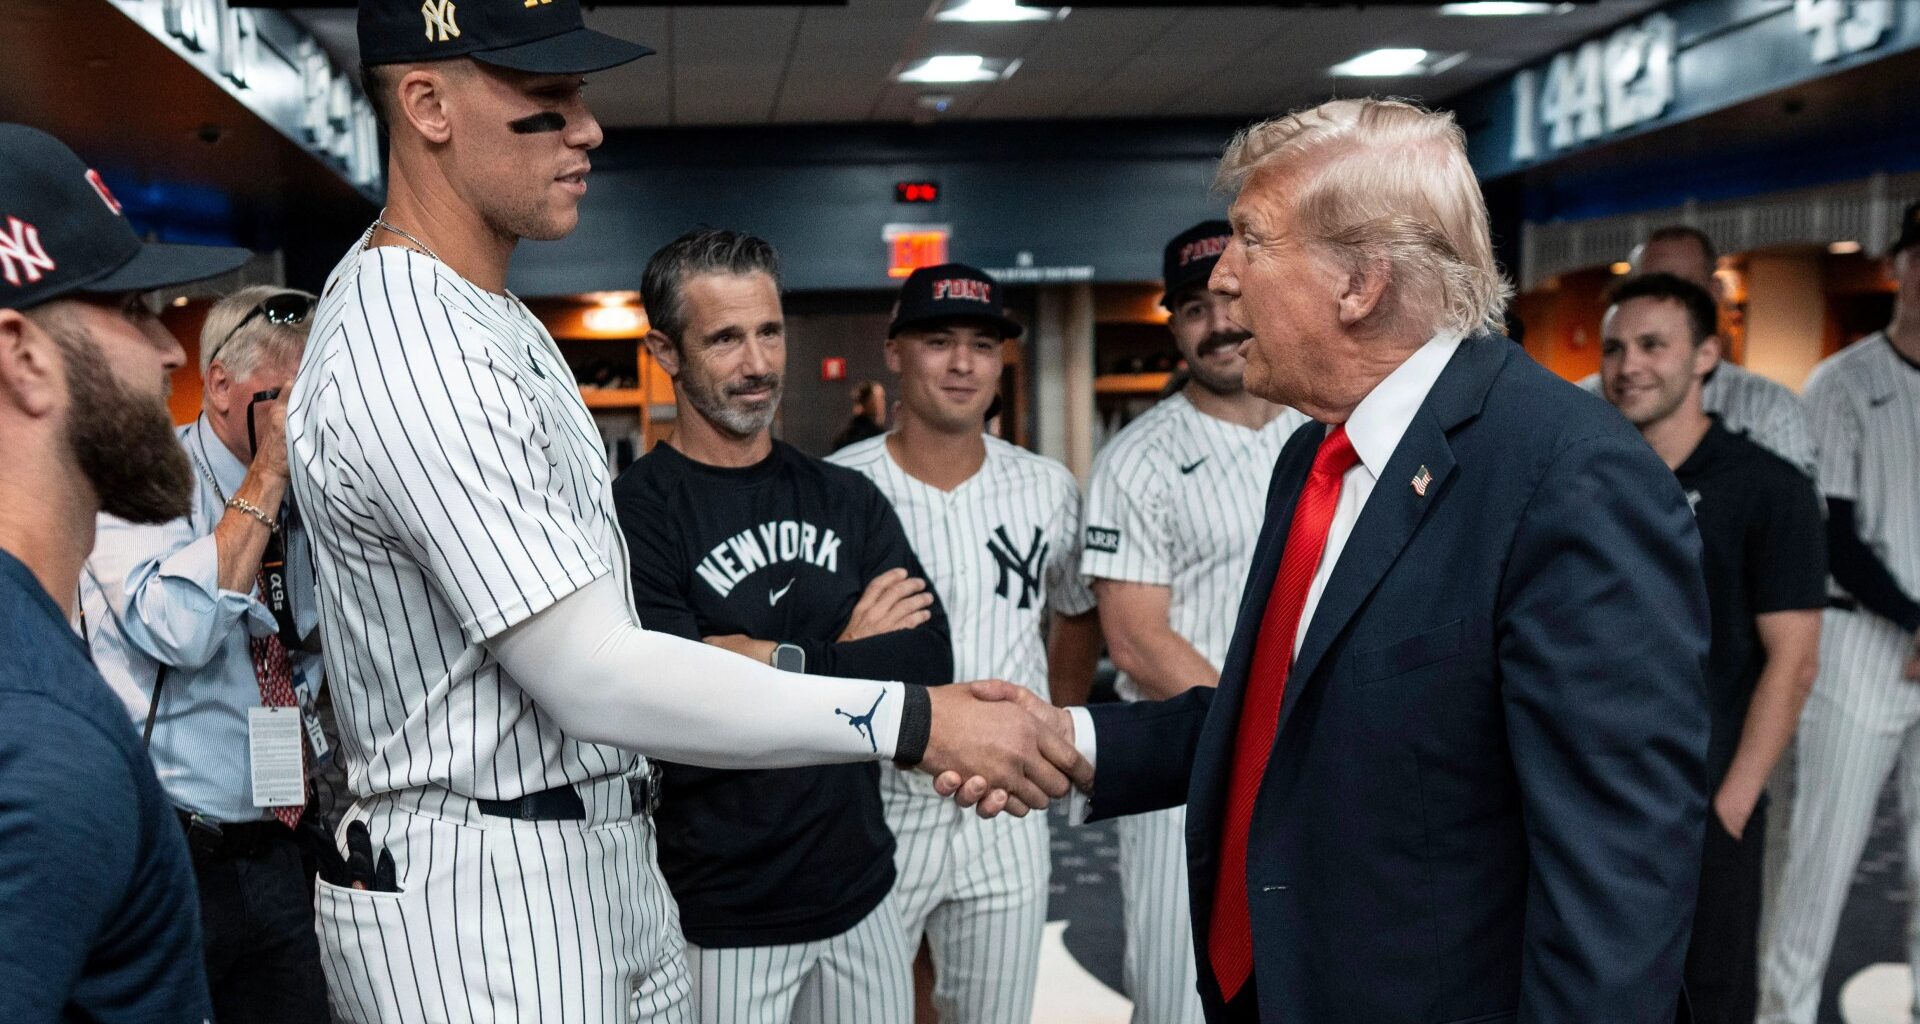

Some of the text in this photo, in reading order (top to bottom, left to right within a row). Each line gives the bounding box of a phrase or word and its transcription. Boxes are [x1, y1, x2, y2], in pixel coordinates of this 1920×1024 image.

[421, 0, 461, 42] NY
[0, 214, 56, 286] NY
[933, 278, 991, 303] FDNY
[695, 520, 842, 598] NEW YORK
[986, 525, 1049, 609] NY
